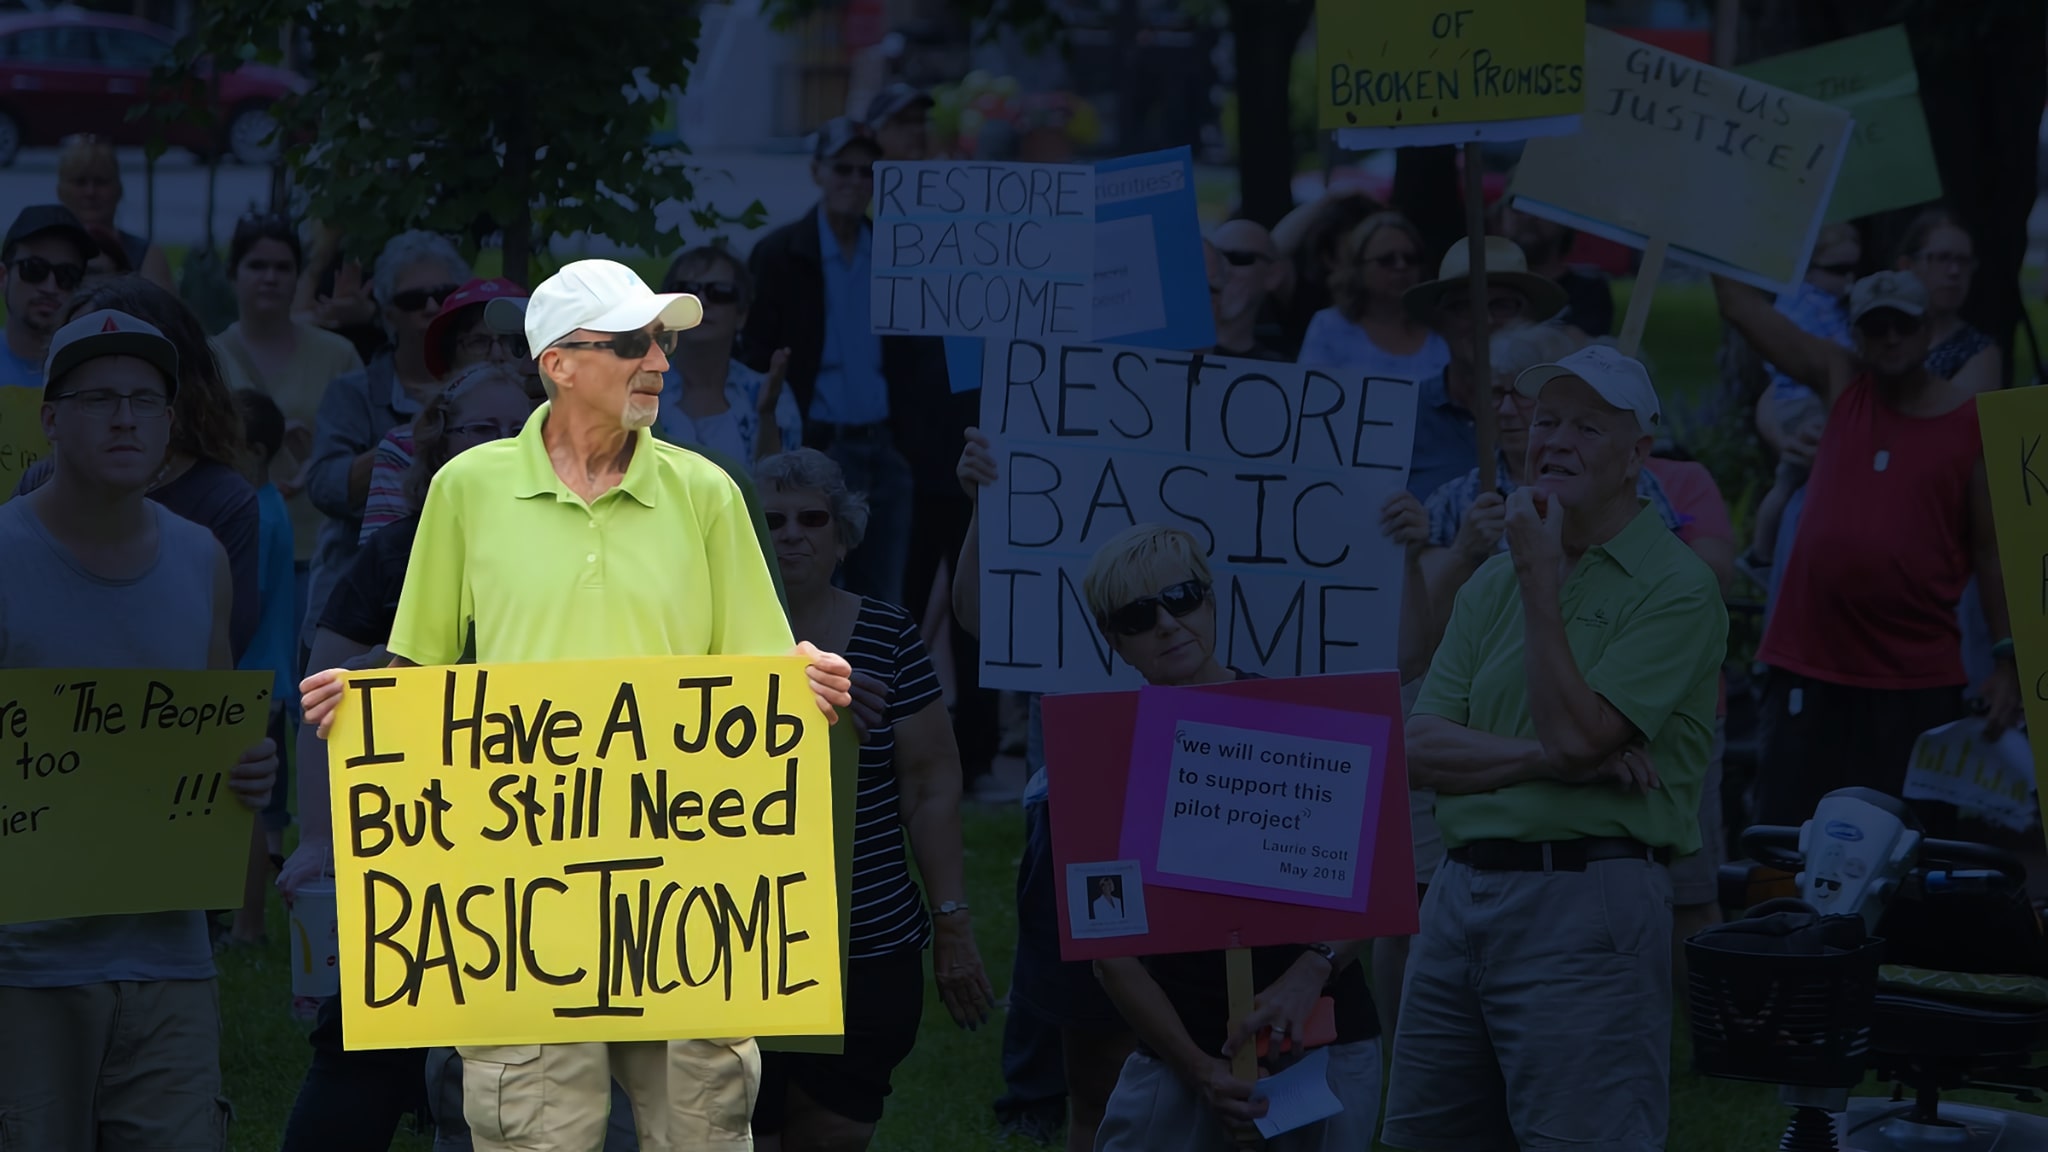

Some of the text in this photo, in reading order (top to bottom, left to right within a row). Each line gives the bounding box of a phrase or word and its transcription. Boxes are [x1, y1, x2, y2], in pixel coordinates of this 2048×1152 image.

[1432, 9, 1474, 40] OF
[1331, 48, 1584, 107] BROKEN PROMISES
[1626, 48, 1791, 127] GIVE US
[1593, 88, 1825, 184] JUSTICE!
[879, 166, 1087, 217] RESTORE
[892, 220, 1052, 270] BASIC
[874, 271, 1085, 337] INCOME
[1000, 340, 1414, 471] RESTORE
[1008, 451, 1351, 569] BASIC
[985, 566, 1380, 678] INME
[54, 681, 126, 734] "The
[345, 669, 805, 770] I Have A Job
[16, 742, 80, 780] too
[1179, 767, 1333, 803] to support this
[1218, 743, 1253, 761] will
[1260, 751, 1352, 774] continue
[349, 757, 799, 858] But Still Need
[1174, 799, 1222, 819] pilot
[1262, 839, 1349, 862] Laurie Scott
[1279, 862, 1346, 882] May 2018
[363, 855, 820, 1018] BASIC INCOME
